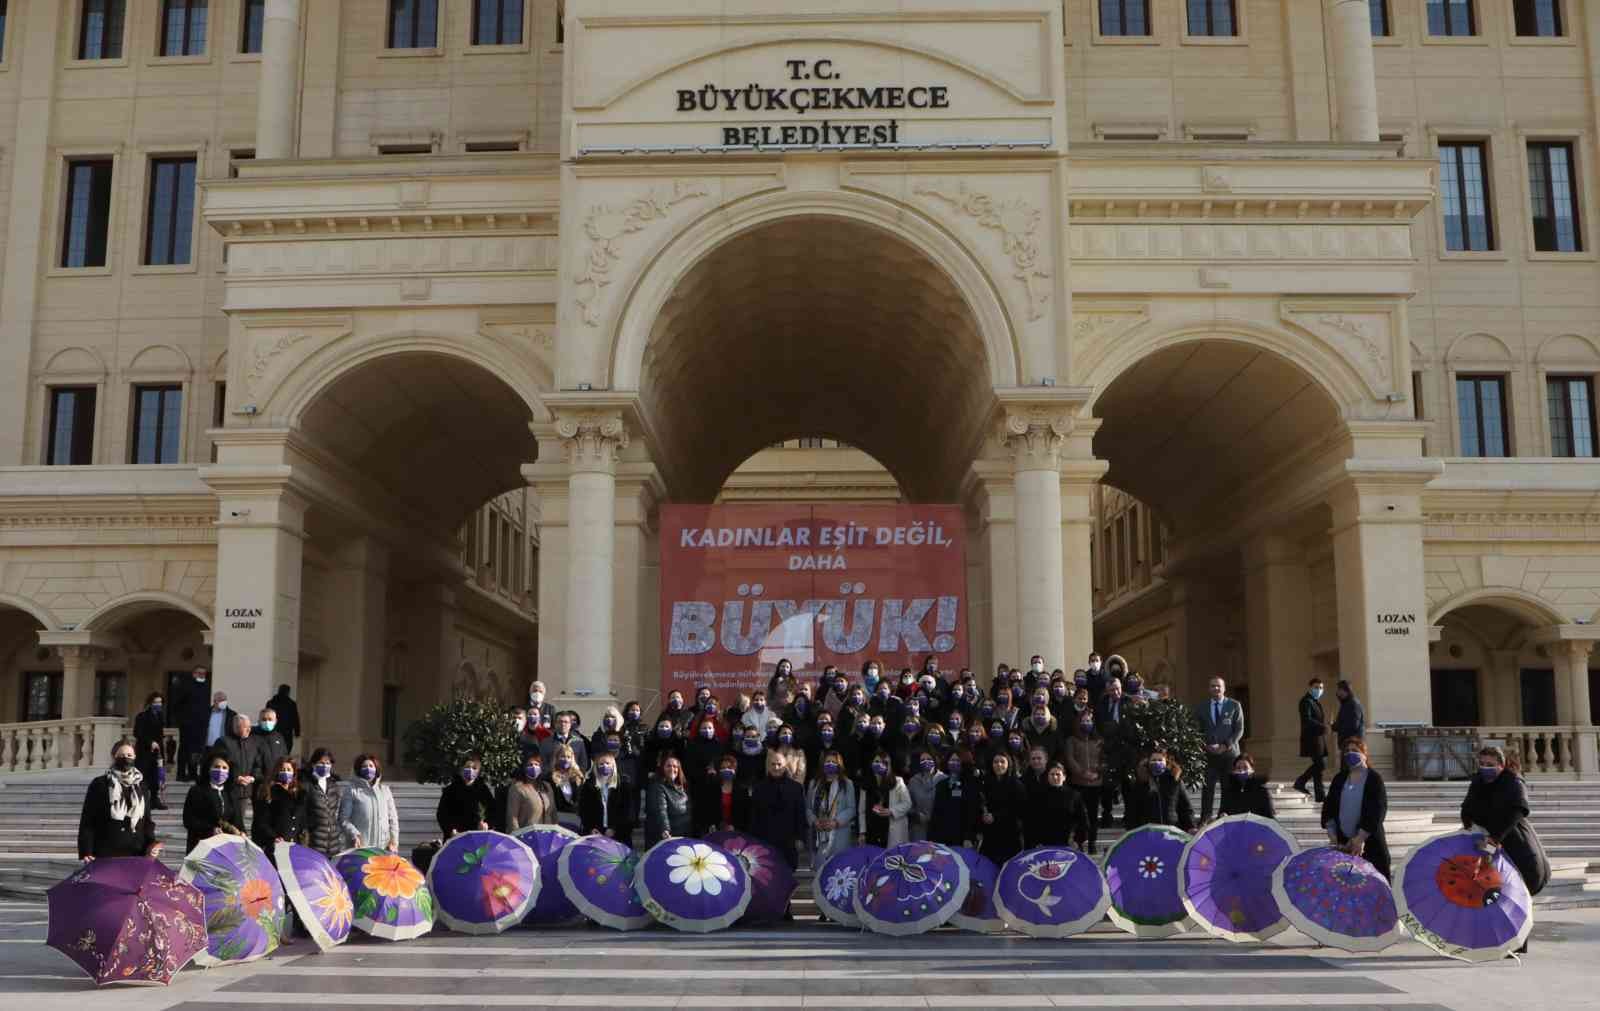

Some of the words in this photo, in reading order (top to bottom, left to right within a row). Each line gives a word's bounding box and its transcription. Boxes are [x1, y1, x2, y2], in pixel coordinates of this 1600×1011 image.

[786, 60, 841, 80] T.C.
[677, 84, 949, 113] BÜYÜKÇEKMECE
[723, 119, 898, 146] BELEDİYESİ
[680, 527, 811, 547] KADINLAR
[819, 521, 869, 551] EŞİT
[875, 521, 953, 548] DEĞİL,
[788, 554, 847, 570] DAHA
[225, 608, 263, 617] LOZAN
[1377, 614, 1415, 623] LOZAN
